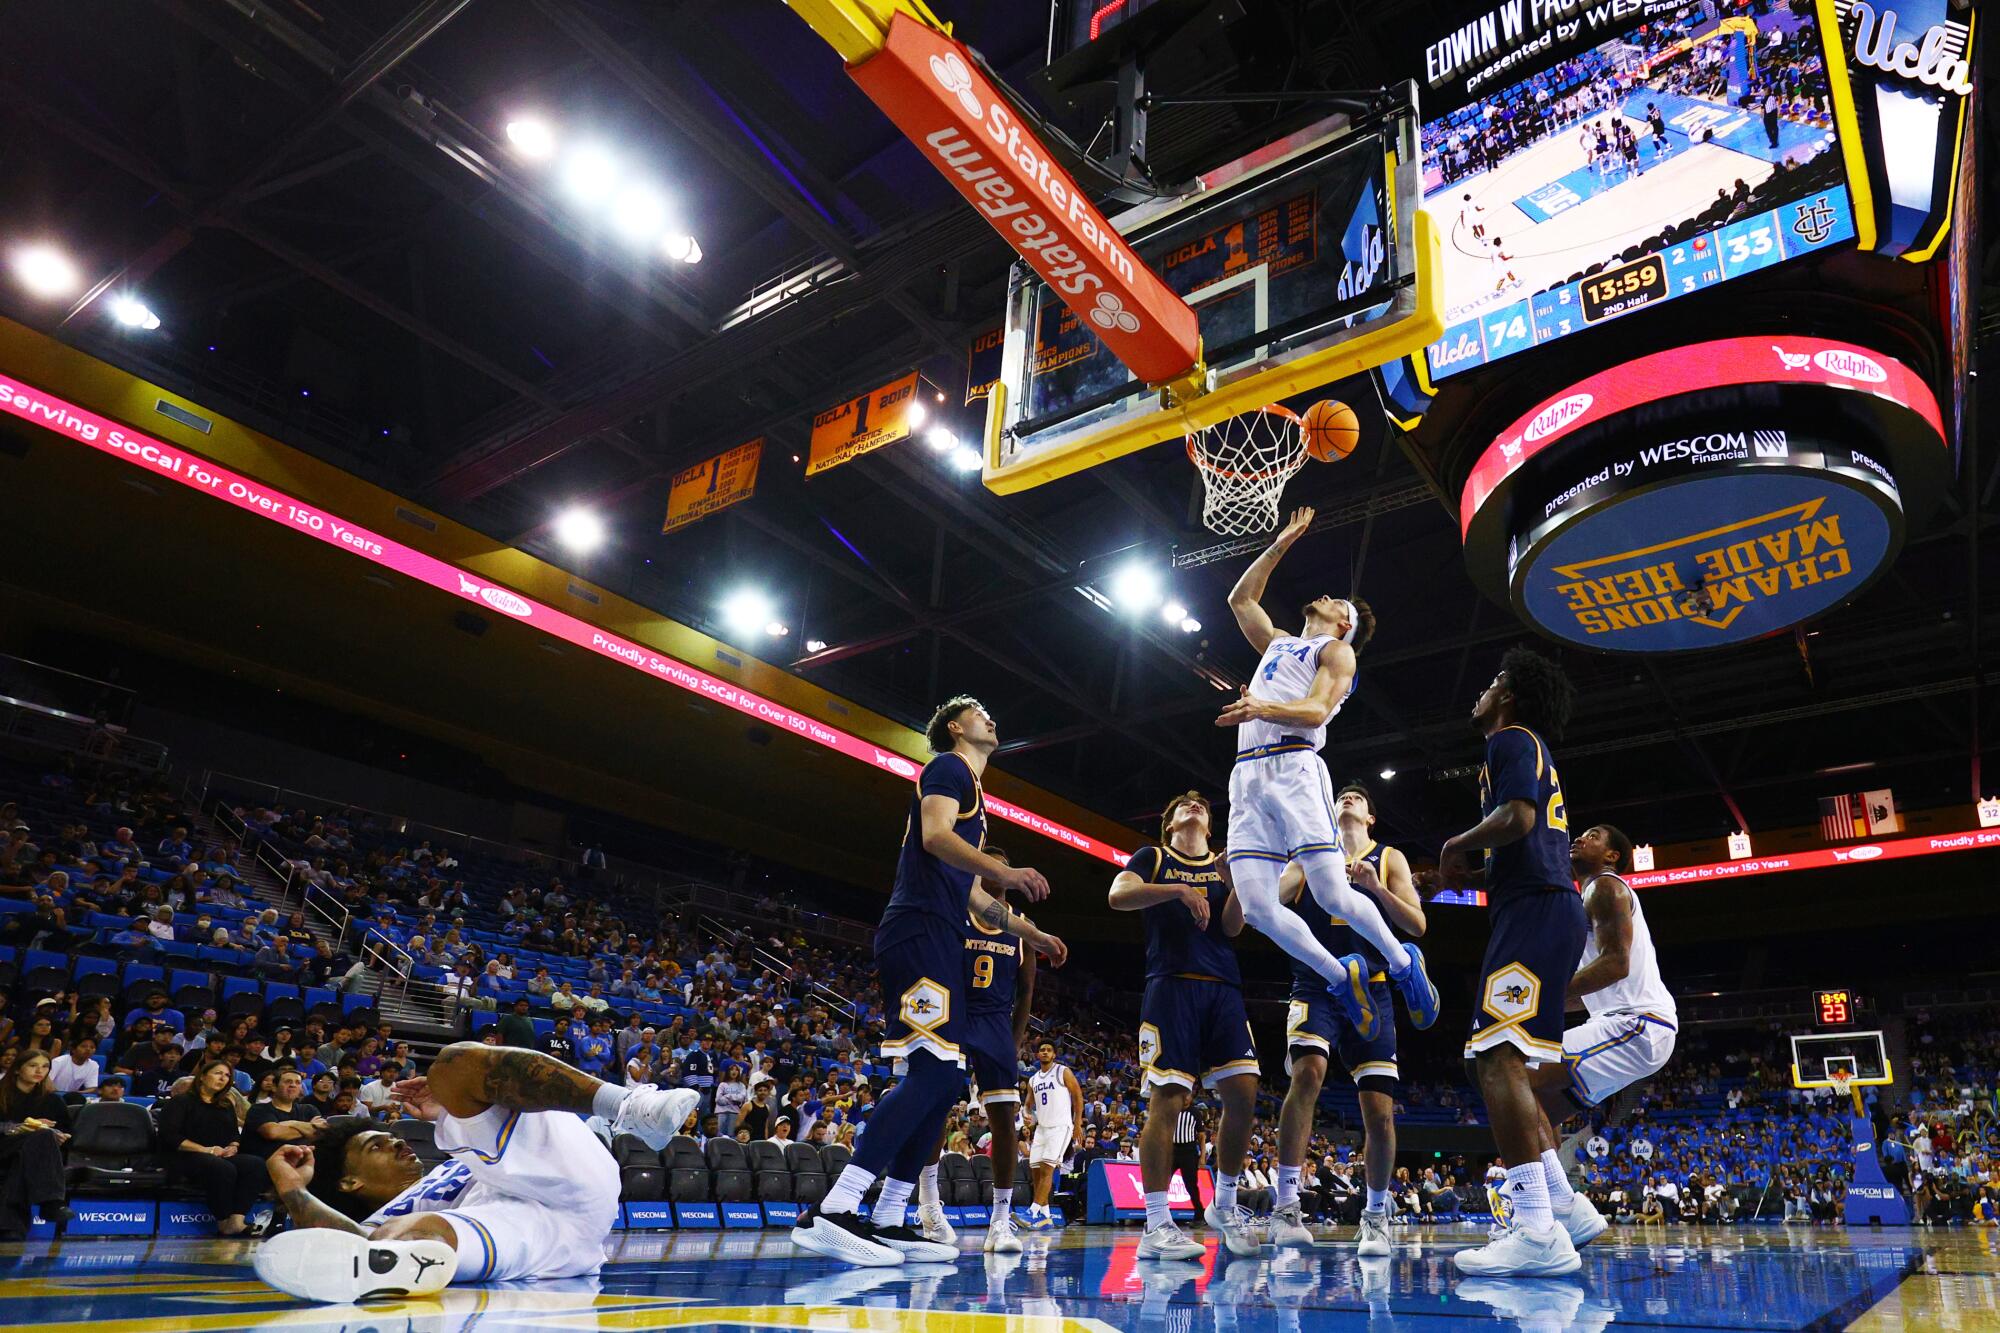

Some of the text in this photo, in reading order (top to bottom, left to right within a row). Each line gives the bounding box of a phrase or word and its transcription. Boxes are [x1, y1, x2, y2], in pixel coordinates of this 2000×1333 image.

[1426, 11, 1498, 83] EDWIN
[1500, 0, 1523, 41] W
[1852, 2, 1973, 95] Ucla
[1466, 30, 1551, 93] presented
[1556, 19, 1580, 39] by
[1165, 235, 1217, 268] UCLA
[1223, 223, 1248, 271] 1
[1672, 247, 1686, 265] 2
[1727, 226, 1774, 263] 33
[1587, 265, 1658, 304] 13:59
[1682, 275, 1696, 292] 3
[1558, 289, 1571, 304] 5
[1604, 293, 1648, 316] 2ND Half
[975, 327, 1004, 353] UCL
[1489, 315, 1527, 348] 74
[1559, 320, 1572, 336] 3
[1429, 333, 1481, 369] Ucla
[1825, 352, 1880, 379] Ralphs
[880, 385, 911, 409] 2018
[815, 404, 852, 428] UCLA
[852, 395, 870, 438] 1
[1532, 398, 1584, 438] Ralphs
[0, 384, 384, 555] Serving SoCal for Over 150 Years
[815, 450, 852, 470] NATIONAL
[1691, 449, 1748, 465] Financial
[673, 464, 706, 488] UCLA
[707, 458, 720, 495] 1
[1545, 431, 1748, 518] presented by WESCOM
[1557, 514, 1845, 611] MADE HERE
[1263, 654, 1283, 680] 4
[592, 634, 837, 744] Proudly Serving SoCal for Over 150 Years
[985, 800, 1090, 849] erving SoCal for Over 150 Years
[1984, 810, 1999, 819] 32
[1930, 835, 1975, 849] Proudly
[1632, 874, 1667, 887] Serving
[1669, 870, 1697, 882] SoCal
[1699, 869, 1713, 879] for
[1715, 864, 1739, 876] Over
[1741, 862, 1759, 873] 150
[1761, 859, 1789, 870] Years
[965, 939, 1016, 957] NTEATERS
[972, 955, 994, 988] 9
[1821, 992, 1847, 1004] 13:59
[1823, 1004, 1846, 1022] 23
[1034, 1081, 1055, 1094] UCLA
[1041, 1092, 1047, 1106] 8
[1634, 1145, 1650, 1154] Ucla
[1849, 1187, 1881, 1196] WESCOM
[79, 1212, 134, 1223] WESCOM
[681, 1211, 709, 1219] WESCOM
[769, 1210, 791, 1218] WESCOM
